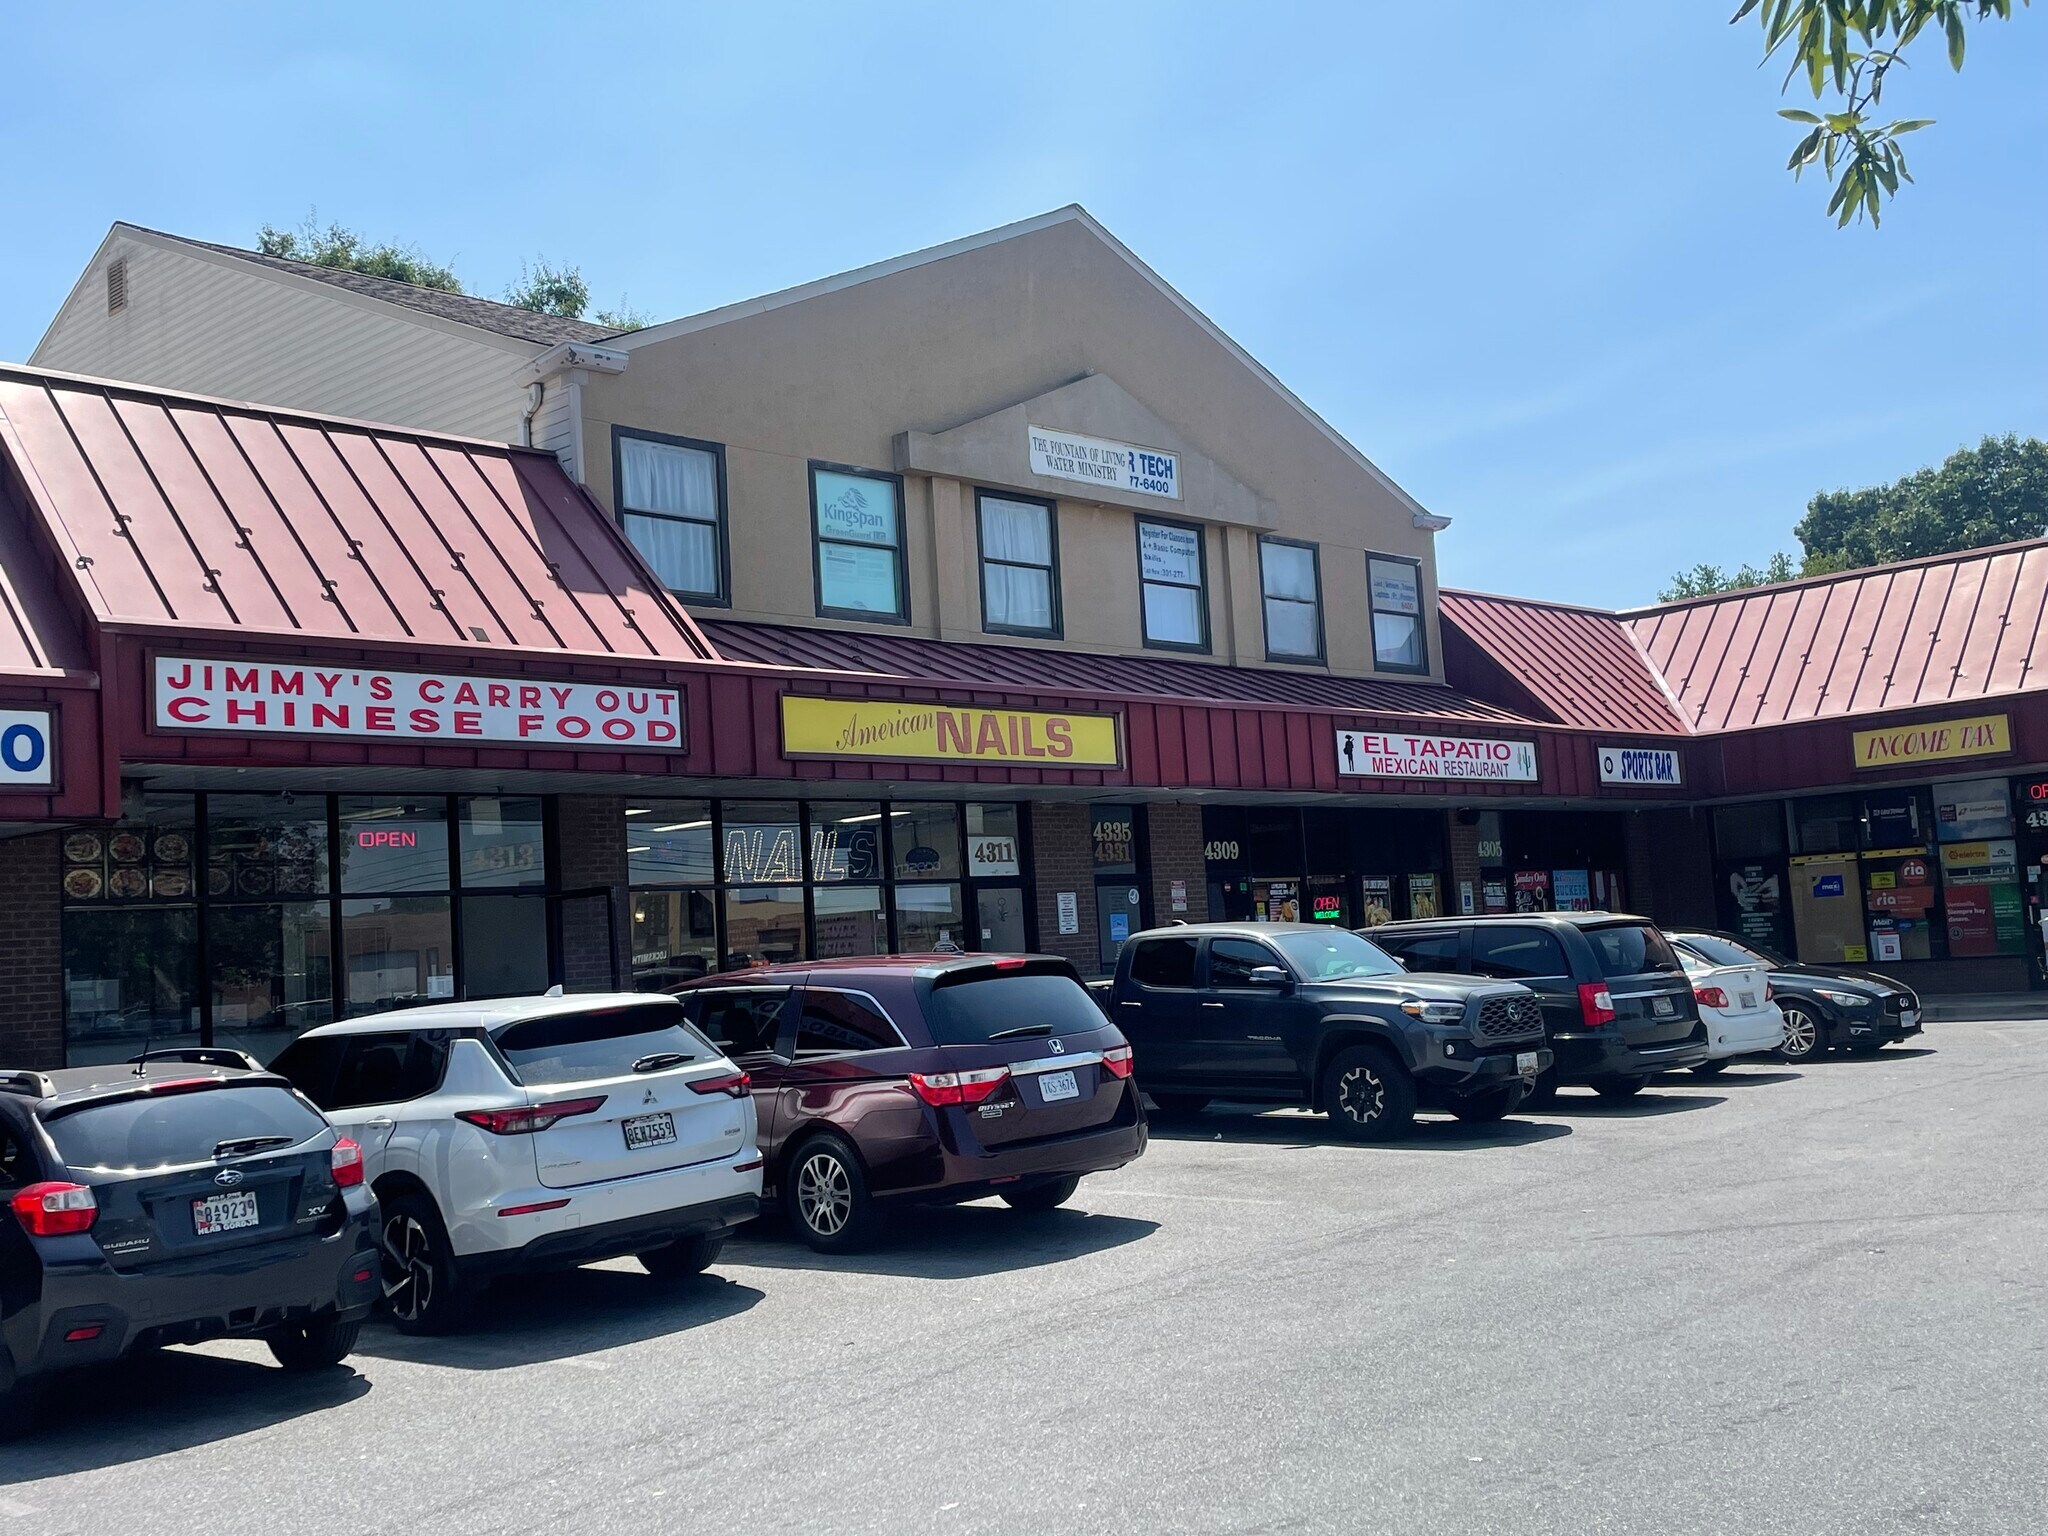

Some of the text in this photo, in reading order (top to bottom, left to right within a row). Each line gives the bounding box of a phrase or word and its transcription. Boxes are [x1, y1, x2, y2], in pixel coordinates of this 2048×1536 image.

[1032, 436, 1126, 467] THE FOUNTAIN OF LIVING
[1046, 455, 1118, 482] WATER MINISTRY
[1139, 453, 1173, 479] TECH
[824, 503, 883, 528] Kingspan
[167, 664, 675, 715] JIMMY'S CARRY OUT
[167, 696, 676, 742] CHINESE FOOD
[836, 709, 1073, 757] American NAILS
[1867, 723, 1996, 760] INCOME TAX
[1363, 735, 1511, 761] EL TAPATIO
[1372, 757, 1509, 778] MEXICAN RESTAURANT
[1621, 750, 1674, 782] SPORTS BAR
[358, 831, 416, 847] OPEN
[1093, 821, 1132, 842] 4335
[474, 845, 534, 869] 4313
[723, 829, 876, 883] NAILS
[975, 842, 1014, 863] 4311
[1094, 842, 1131, 862] 4331
[1204, 841, 1239, 860] 4309
[1477, 840, 1502, 857] 4305
[1904, 862, 1925, 876] ria
[1555, 884, 1587, 897] BUCKETS
[1876, 892, 1897, 906] ria
[1313, 896, 1340, 911] OPEN
[308, 1205, 326, 1216] XV
[103, 1238, 150, 1250] SUBARU
